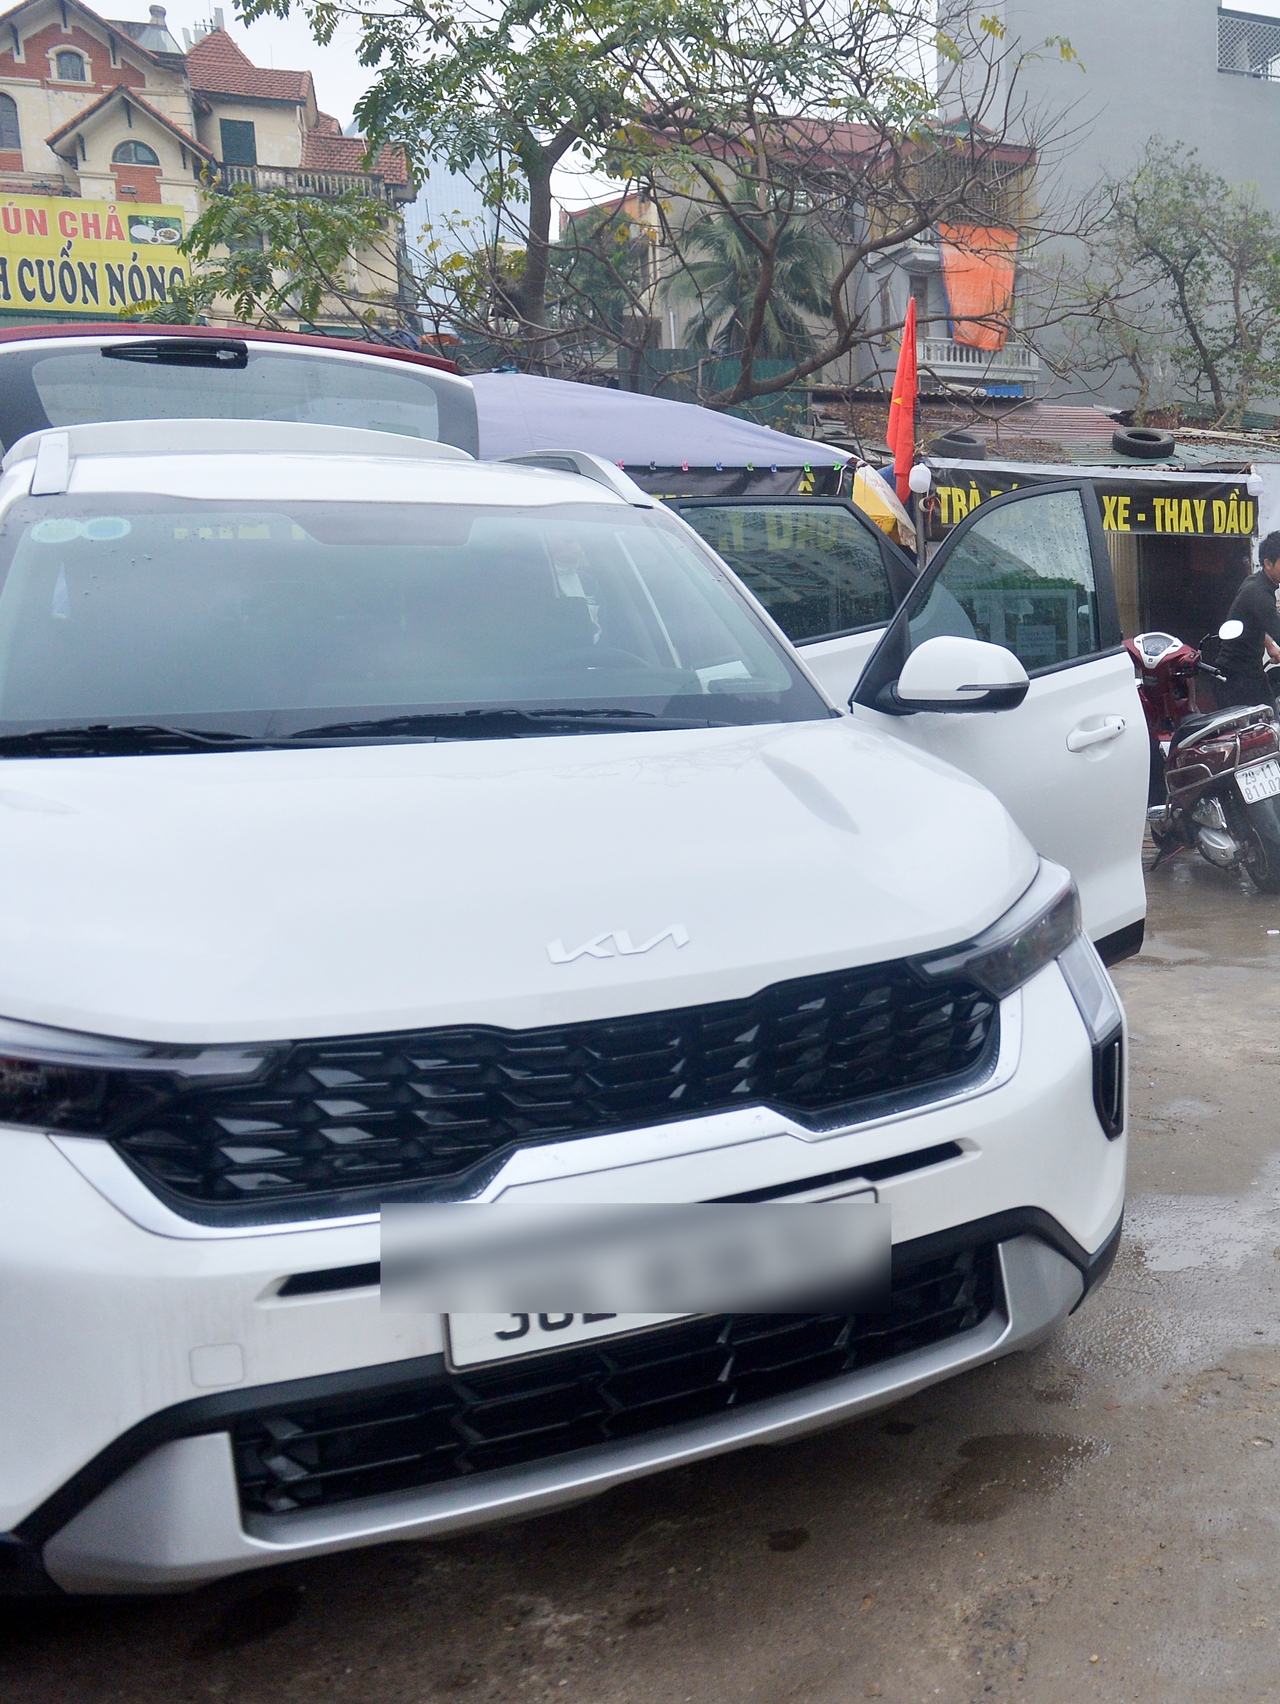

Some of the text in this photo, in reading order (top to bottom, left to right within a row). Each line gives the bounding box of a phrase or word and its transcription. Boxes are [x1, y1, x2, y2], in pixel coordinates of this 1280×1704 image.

[58, 205, 125, 241] CHẢ
[18, 241, 99, 305] CUỐN
[1103, 495, 1131, 532] XE
[1153, 498, 1206, 533] THAY
[1213, 488, 1254, 534] DẦU
